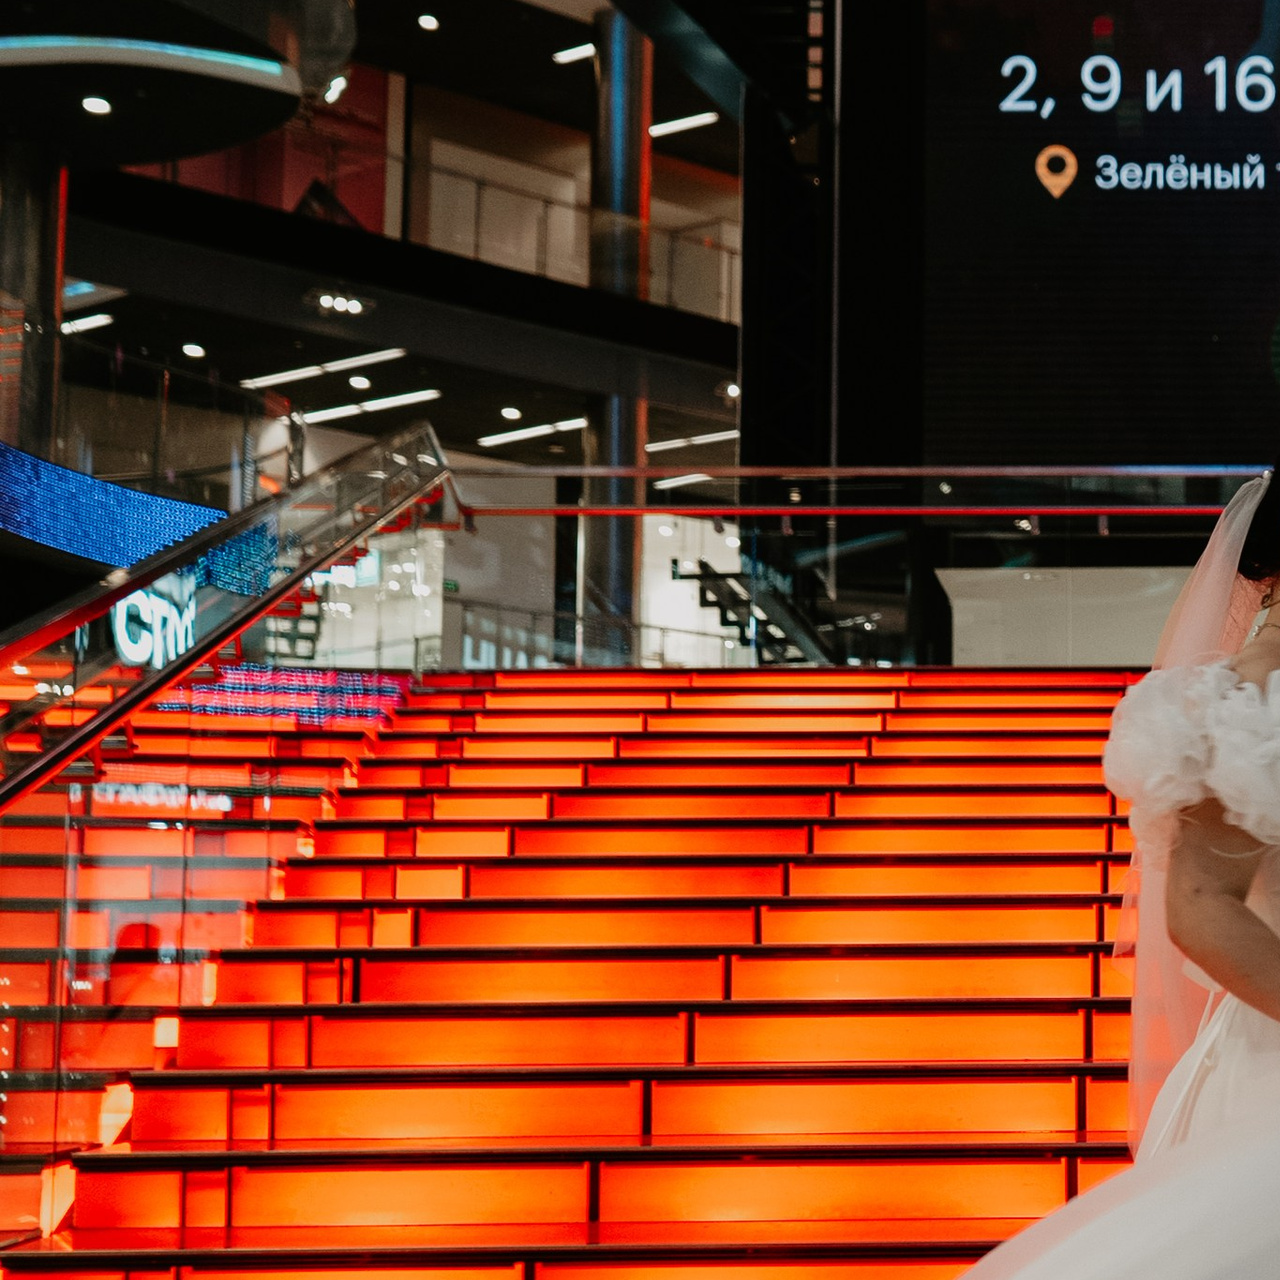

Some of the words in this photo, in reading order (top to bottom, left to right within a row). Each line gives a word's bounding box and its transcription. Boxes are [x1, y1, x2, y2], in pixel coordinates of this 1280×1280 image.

[999, 54, 1056, 119] 2,
[1081, 54, 1122, 114] 9
[1145, 68, 1183, 113] и
[1203, 53, 1277, 114] 16
[1095, 152, 1266, 191] Зелёный
